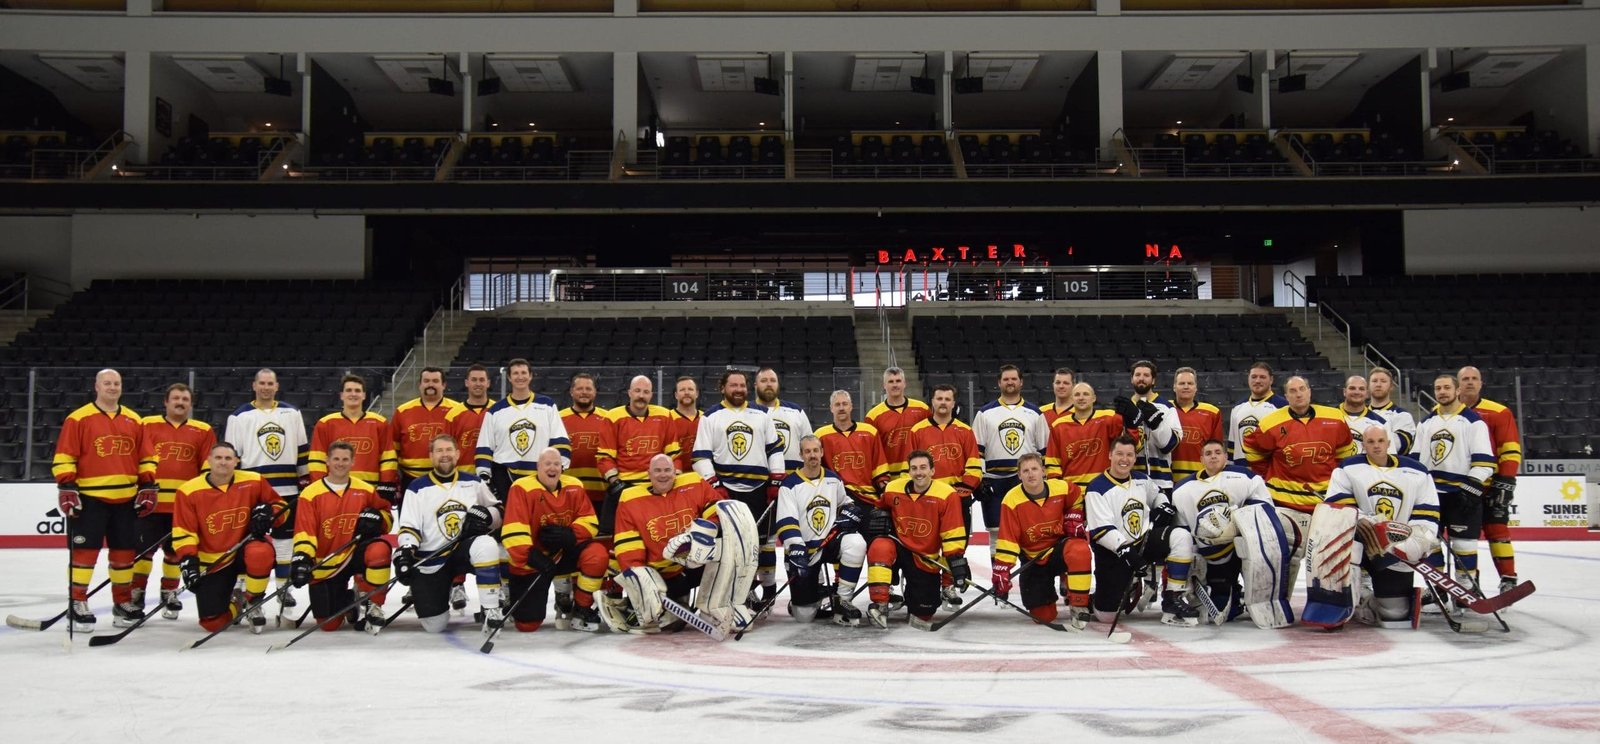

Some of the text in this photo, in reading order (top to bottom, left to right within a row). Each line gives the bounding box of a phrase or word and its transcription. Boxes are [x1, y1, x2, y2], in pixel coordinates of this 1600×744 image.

[878, 244, 1026, 264] BAXTER
[672, 282, 699, 294] 104
[1063, 281, 1089, 293] 105
[1280, 427, 1287, 436] A
[110, 435, 135, 455] FD
[166, 442, 195, 462] FD
[1371, 486, 1399, 497] OMAHA
[1200, 494, 1228, 507] OMAHA
[663, 599, 713, 635] WARRIOR
